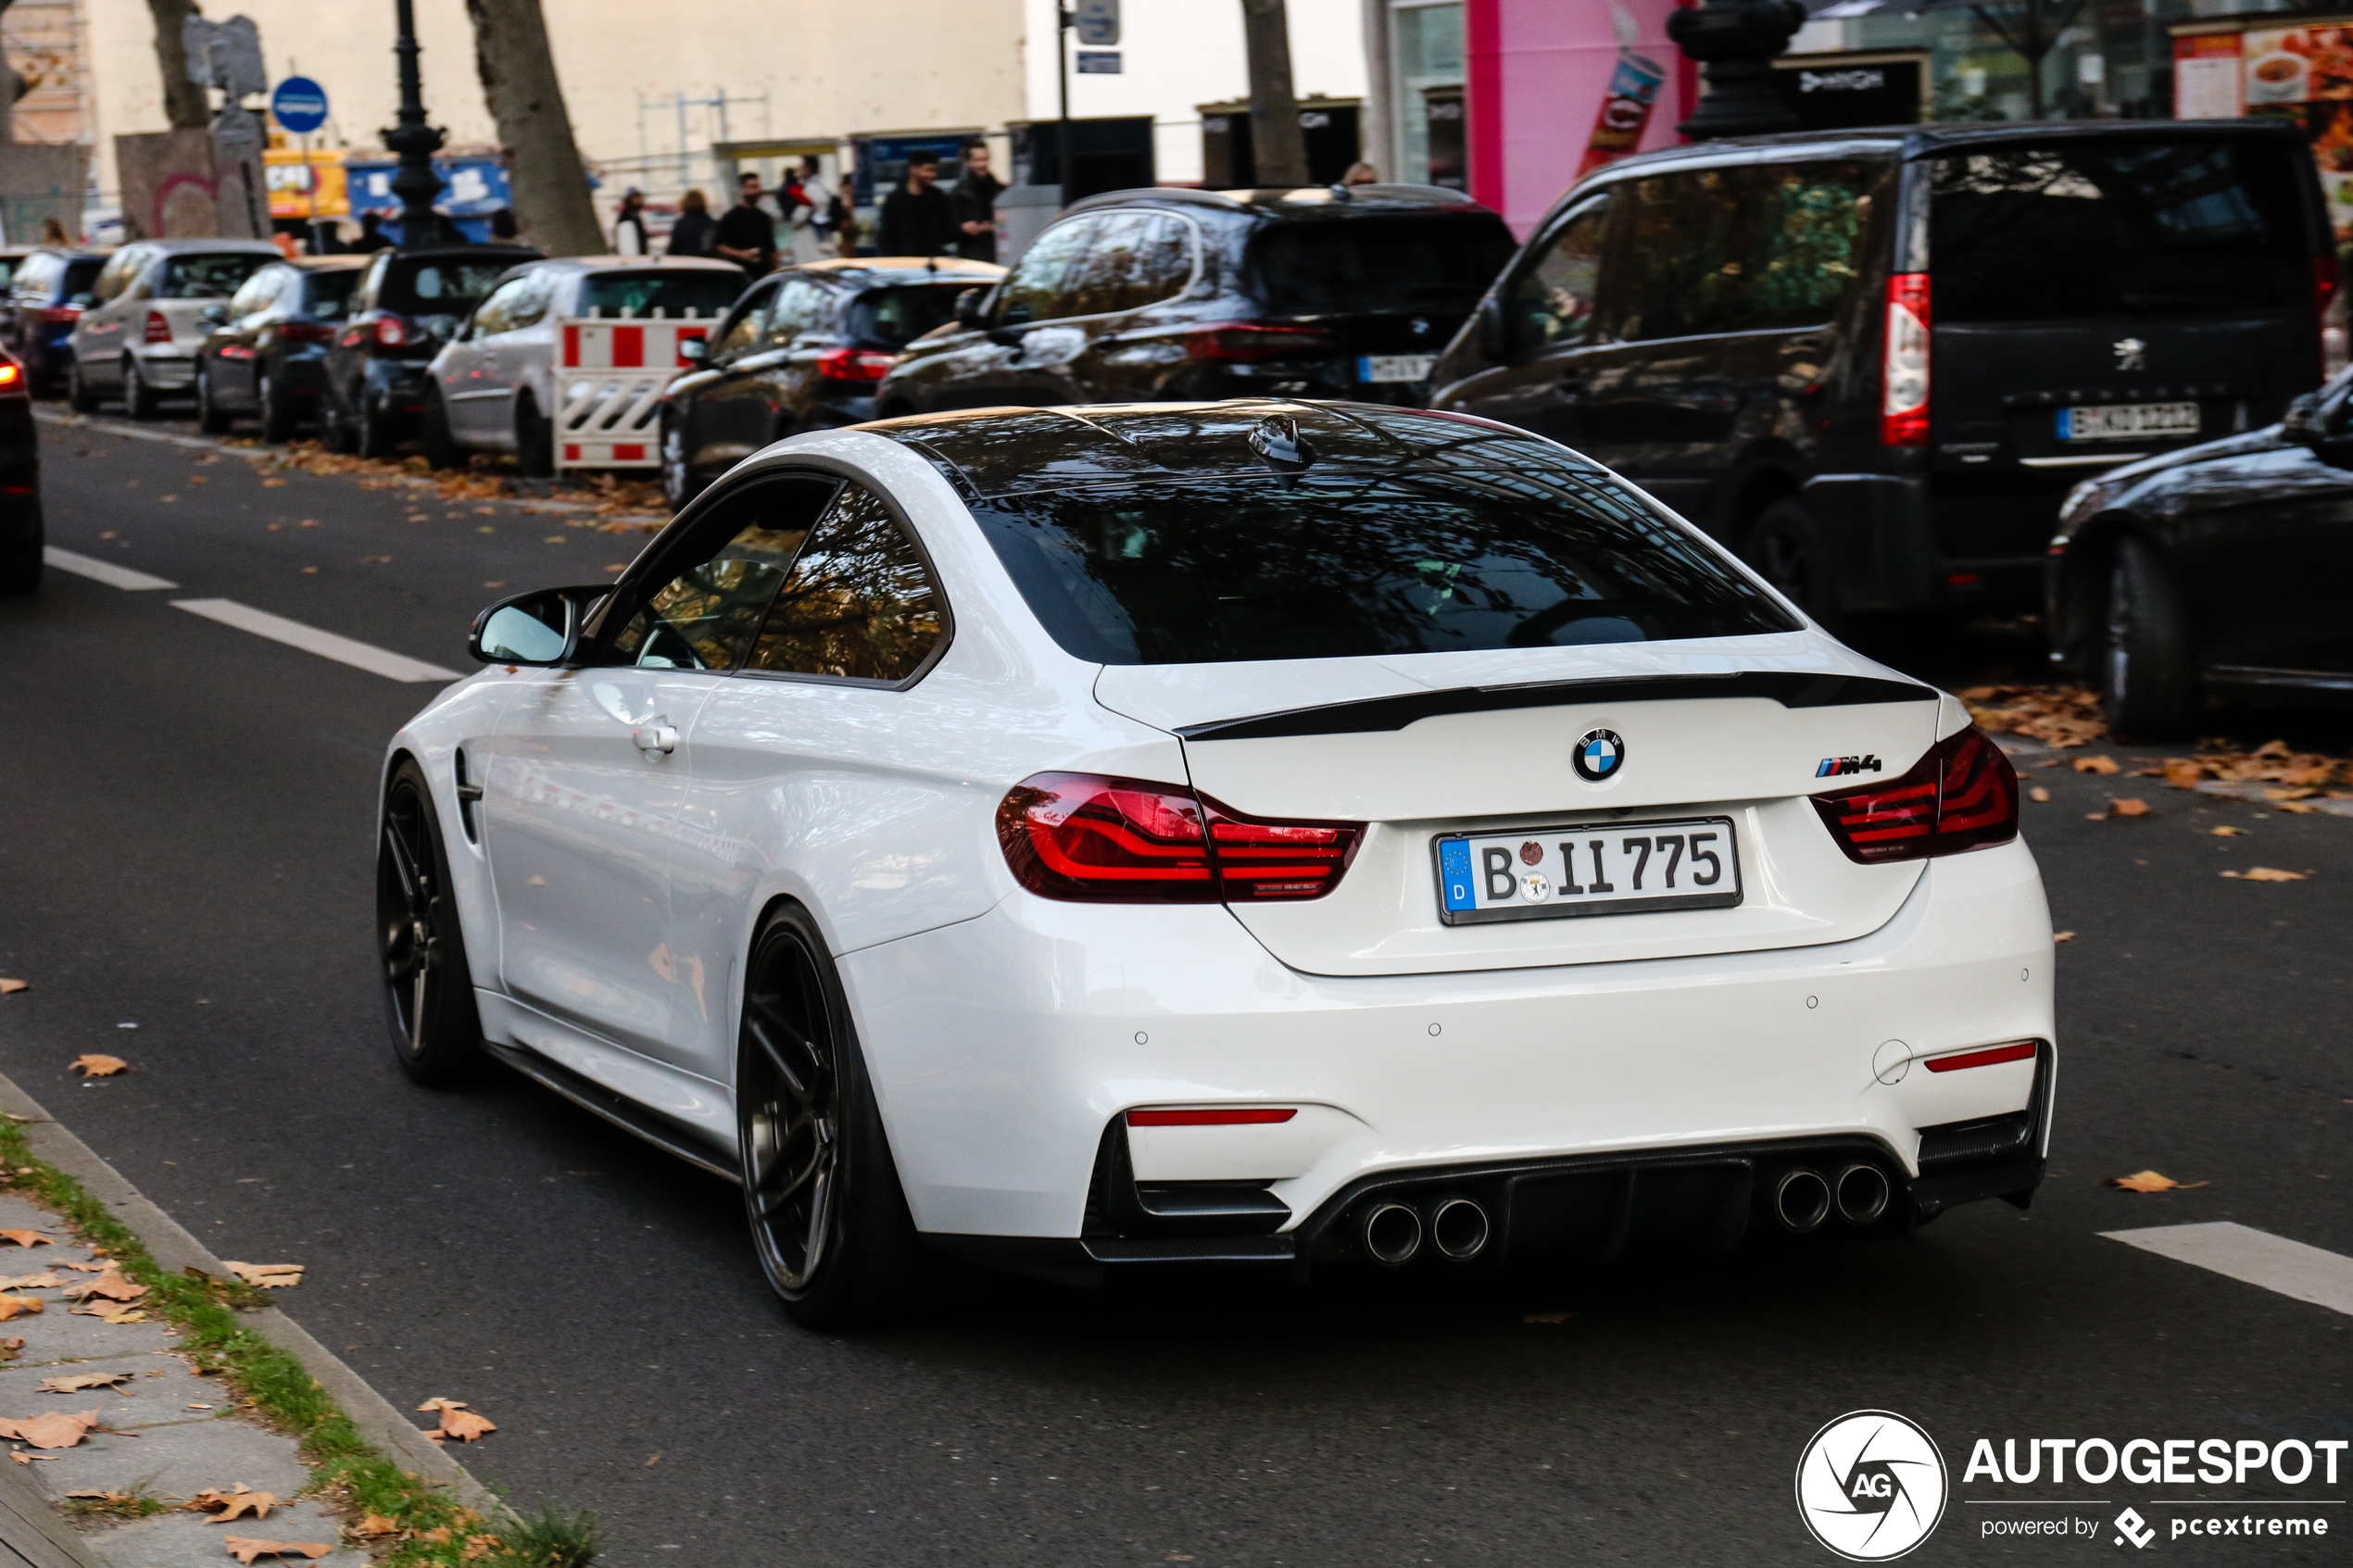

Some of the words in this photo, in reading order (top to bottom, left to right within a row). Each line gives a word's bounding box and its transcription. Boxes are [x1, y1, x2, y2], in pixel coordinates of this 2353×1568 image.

[1579, 729, 1622, 748] BMW
[1831, 754, 1881, 776] M4
[1482, 847, 1517, 900] B
[1453, 884, 1465, 900] D
